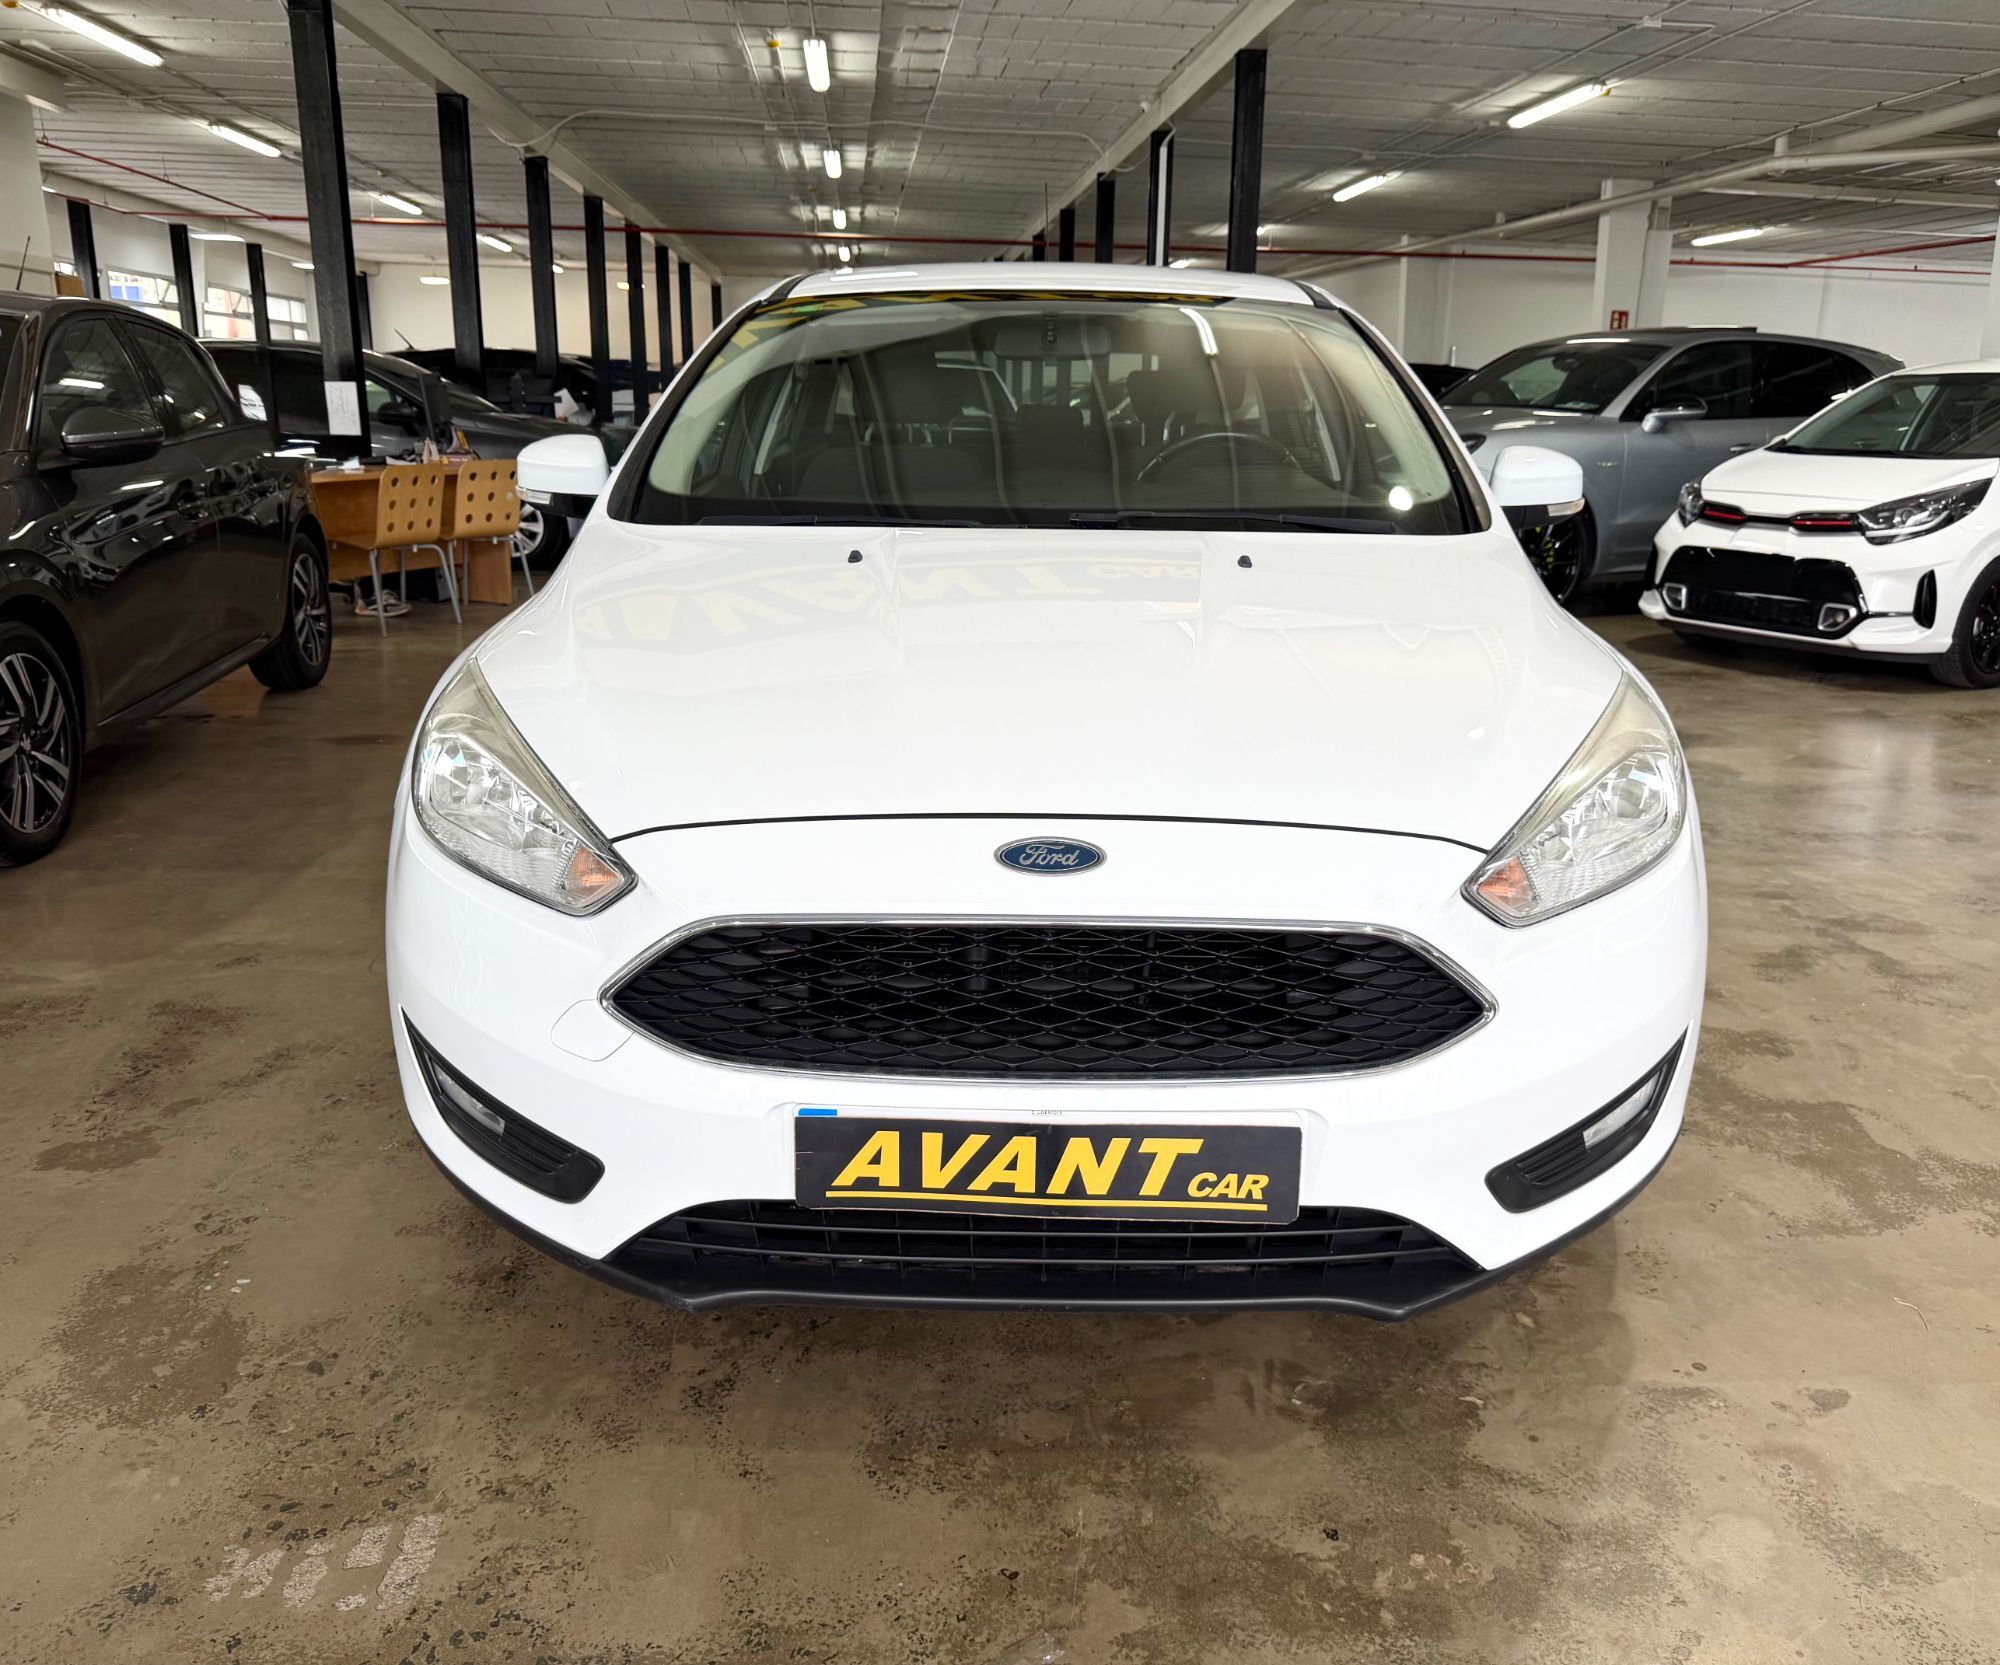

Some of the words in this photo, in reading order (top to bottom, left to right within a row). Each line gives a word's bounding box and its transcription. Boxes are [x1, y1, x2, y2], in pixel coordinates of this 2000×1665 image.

[1019, 844, 1080, 866] Ford
[831, 1130, 1204, 1195] AVANT
[1187, 1172, 1270, 1200] CAR
